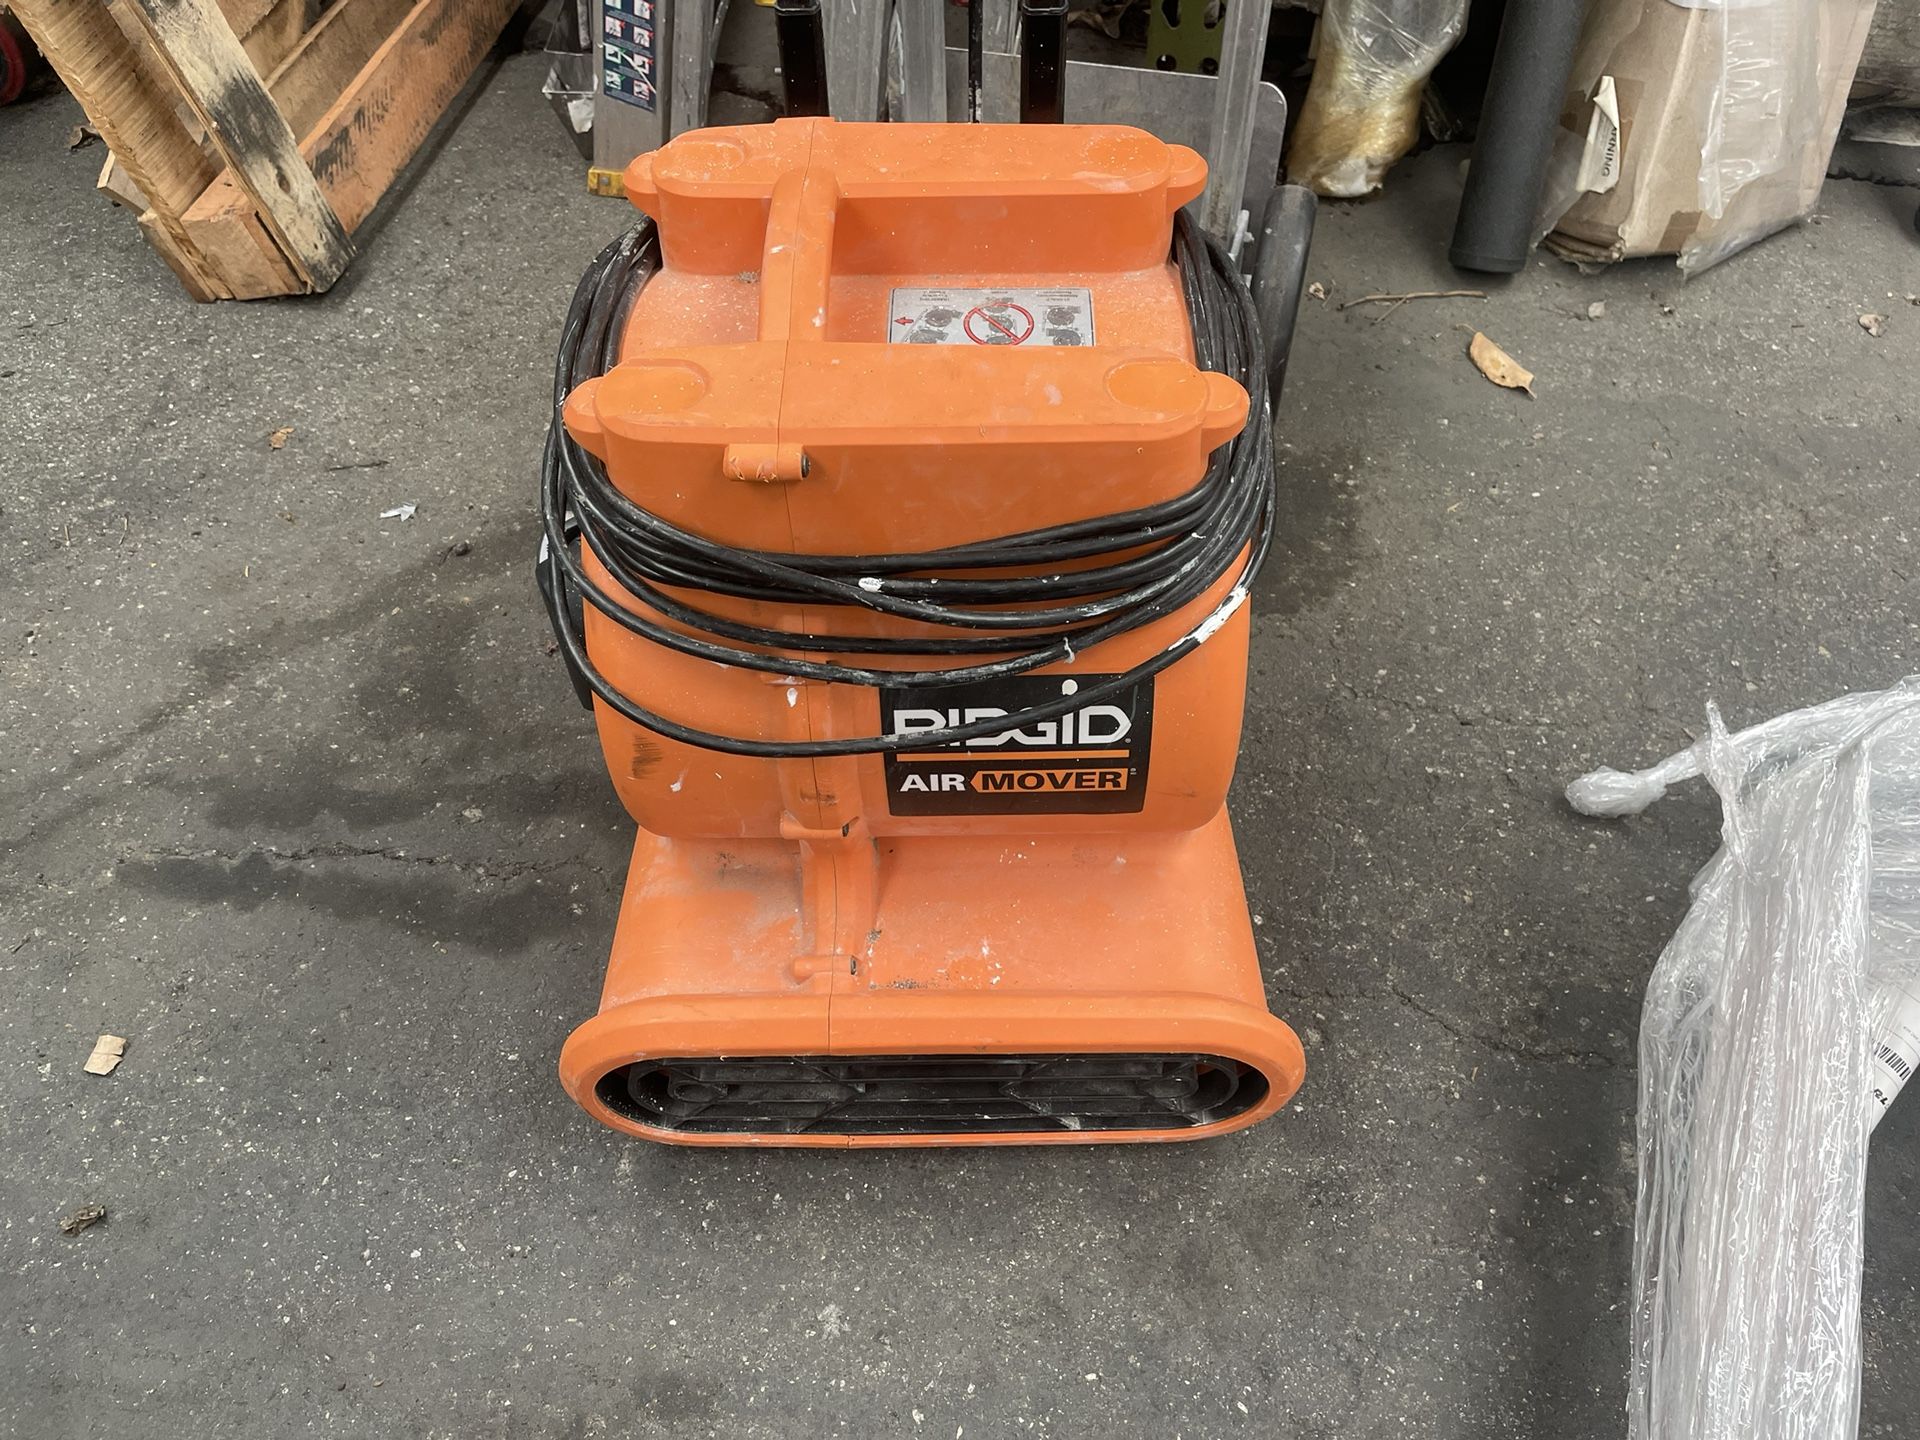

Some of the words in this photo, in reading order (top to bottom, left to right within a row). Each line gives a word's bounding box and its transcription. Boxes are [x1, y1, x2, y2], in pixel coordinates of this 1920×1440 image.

[1602, 126, 1617, 177] ARNING
[899, 773, 966, 792] AIR
[982, 771, 1123, 790] MOVER
